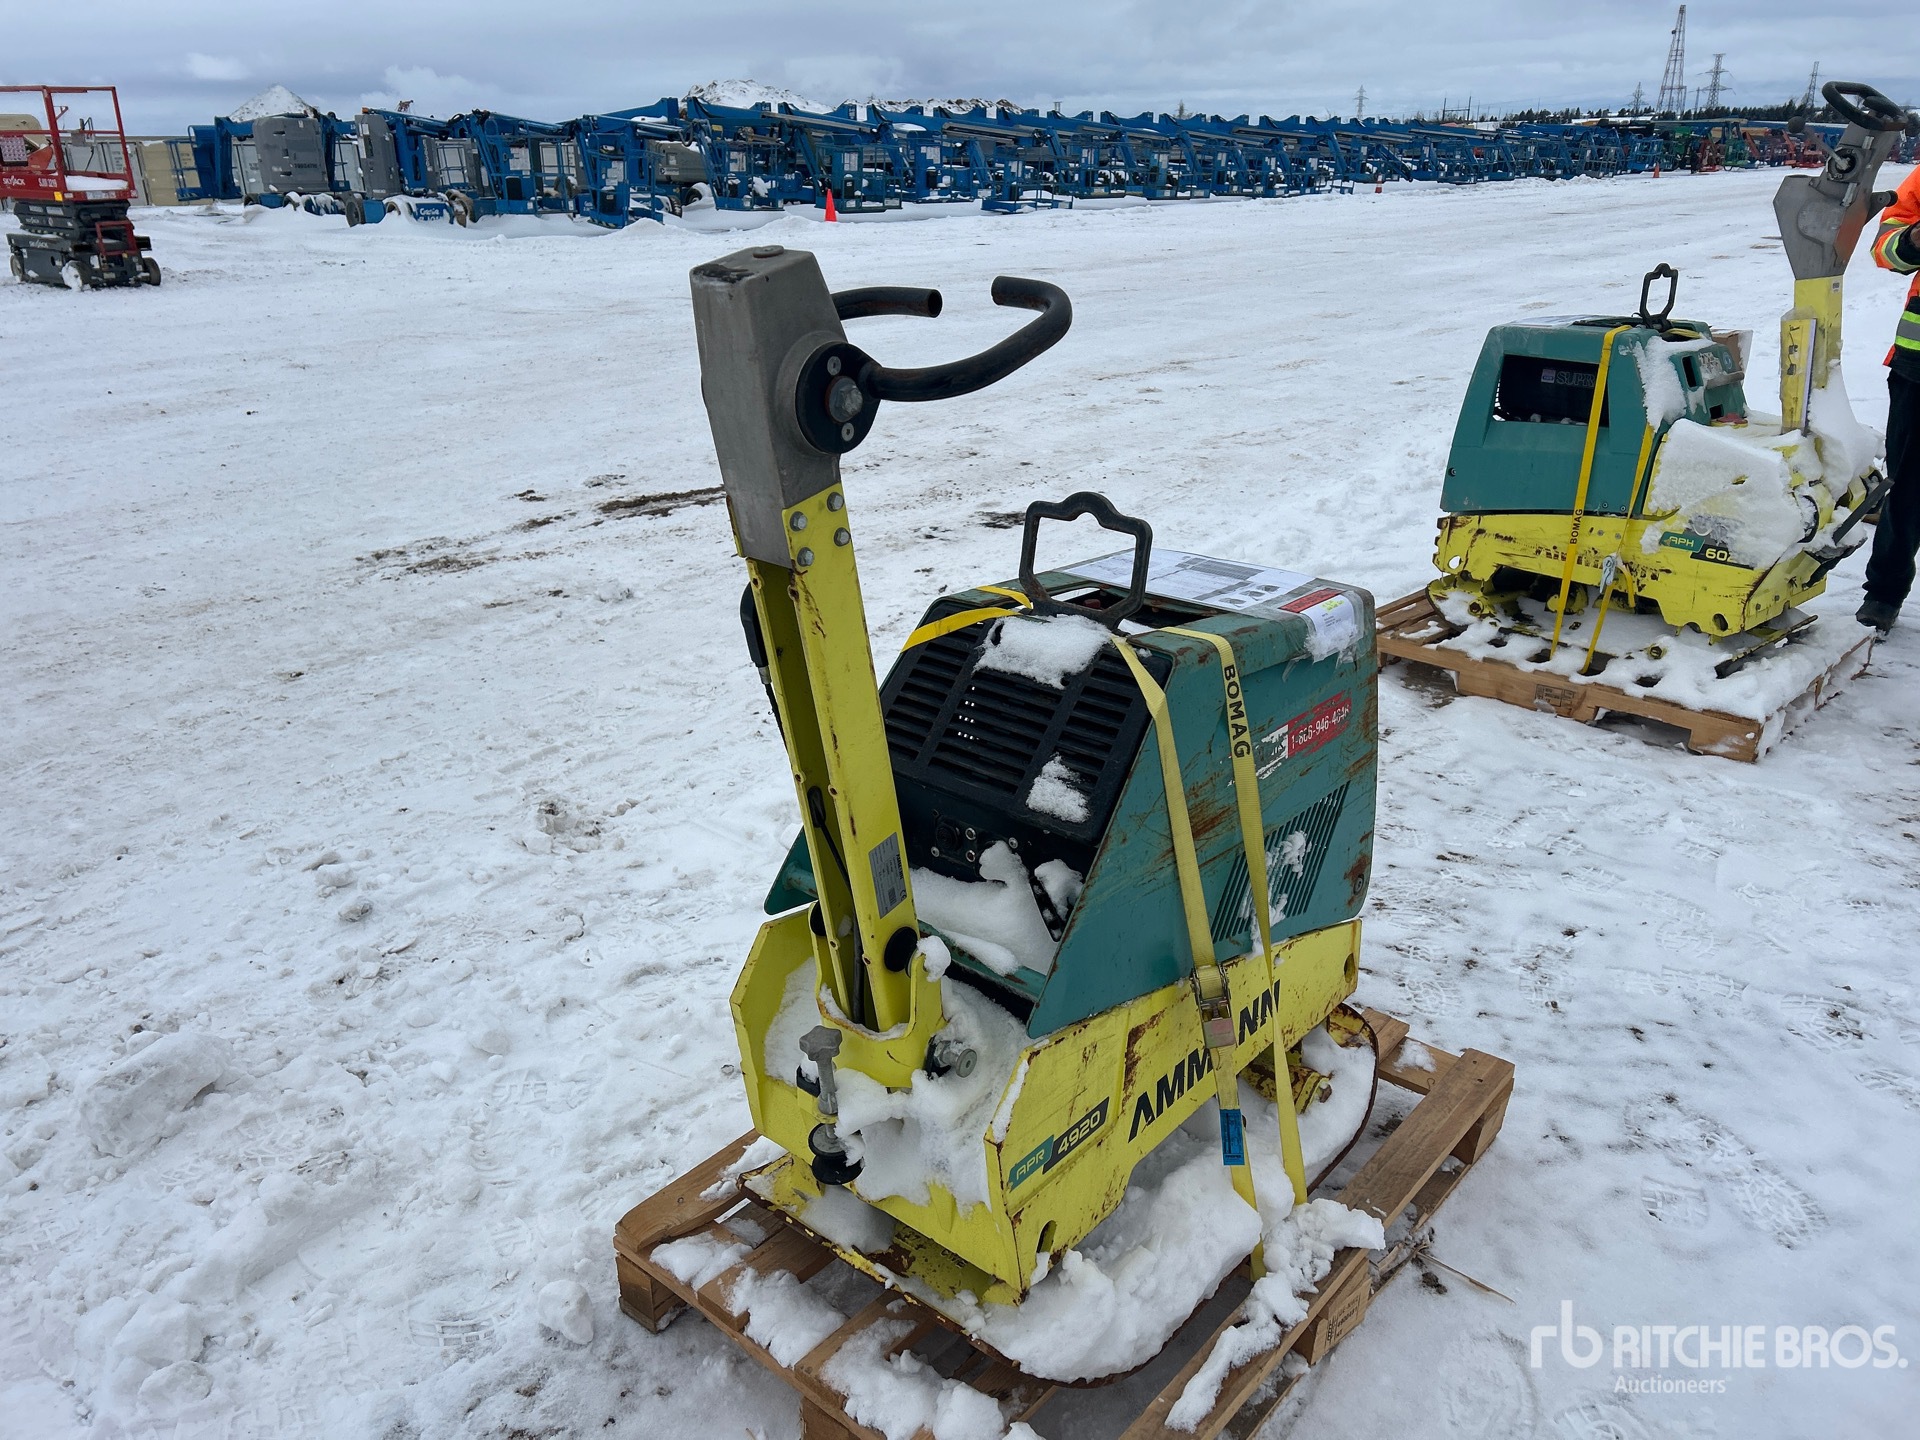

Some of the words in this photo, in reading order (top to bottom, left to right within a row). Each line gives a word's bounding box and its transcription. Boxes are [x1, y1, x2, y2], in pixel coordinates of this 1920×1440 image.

[3, 175, 26, 186] SKYJACK
[1569, 508, 1583, 545] BOMAG
[1223, 664, 1252, 759] BOMAG
[1128, 979, 1281, 1143] AMMNN
[1015, 1148, 1046, 1181] APR
[1057, 1108, 1102, 1153] 4920
